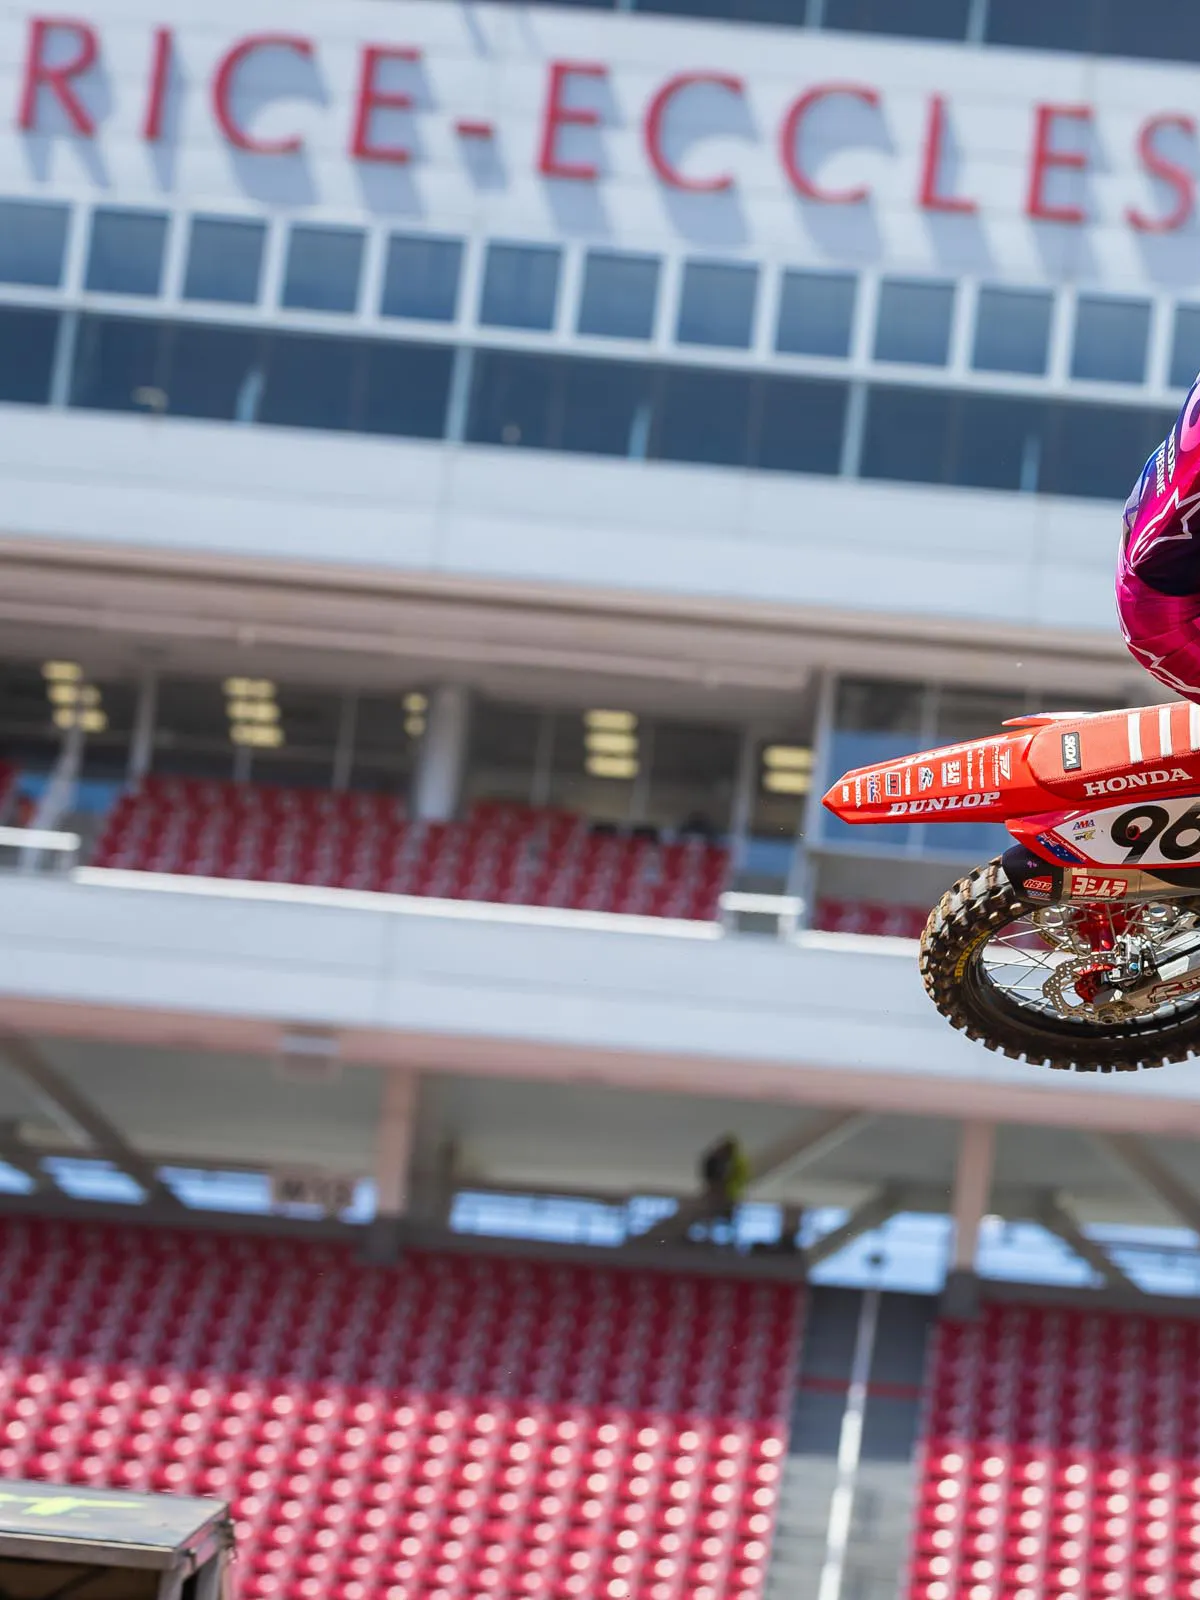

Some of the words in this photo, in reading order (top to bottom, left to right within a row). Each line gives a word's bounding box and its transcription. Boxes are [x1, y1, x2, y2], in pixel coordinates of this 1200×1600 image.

[16, 18, 1199, 233] RICE-ECCLES
[1083, 767, 1193, 798] HONDA
[886, 791, 1000, 816] DUNLOP
[1072, 876, 1127, 897] ヨシムラ
